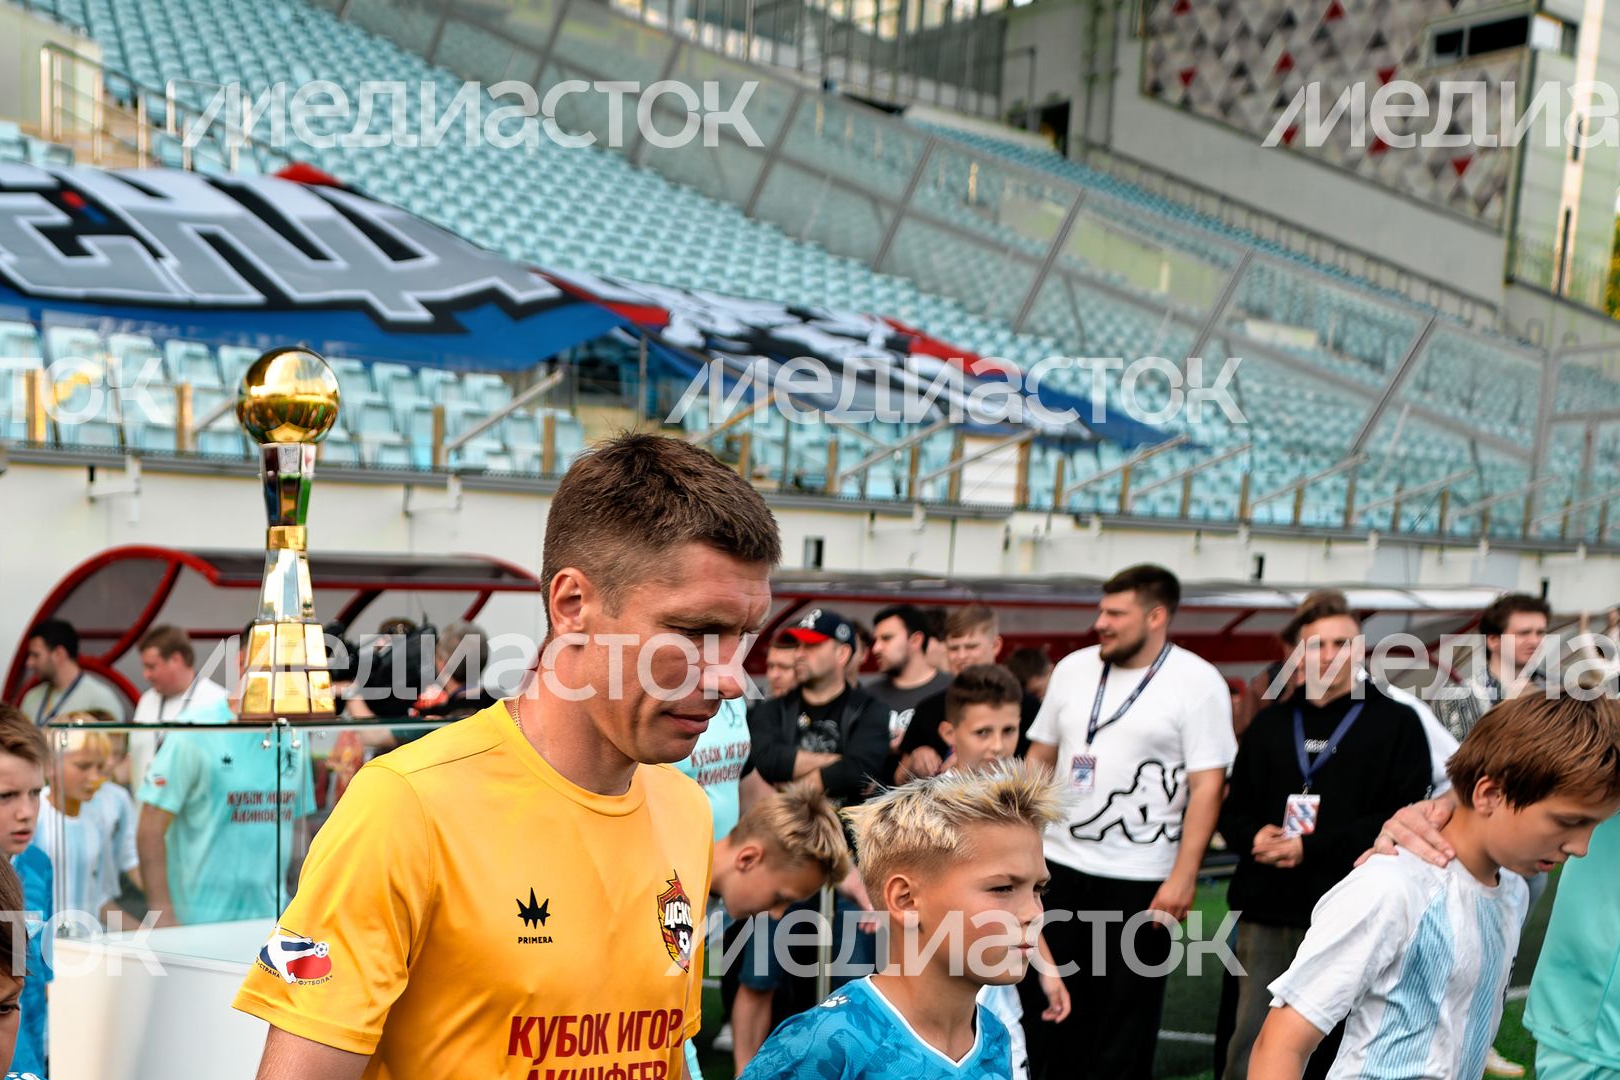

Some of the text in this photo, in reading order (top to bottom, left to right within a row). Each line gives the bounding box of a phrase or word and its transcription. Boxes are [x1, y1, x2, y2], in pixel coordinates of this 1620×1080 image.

[517, 935, 553, 944] PRIMERA
[507, 1008, 684, 1066] КУБОК ИГОР
